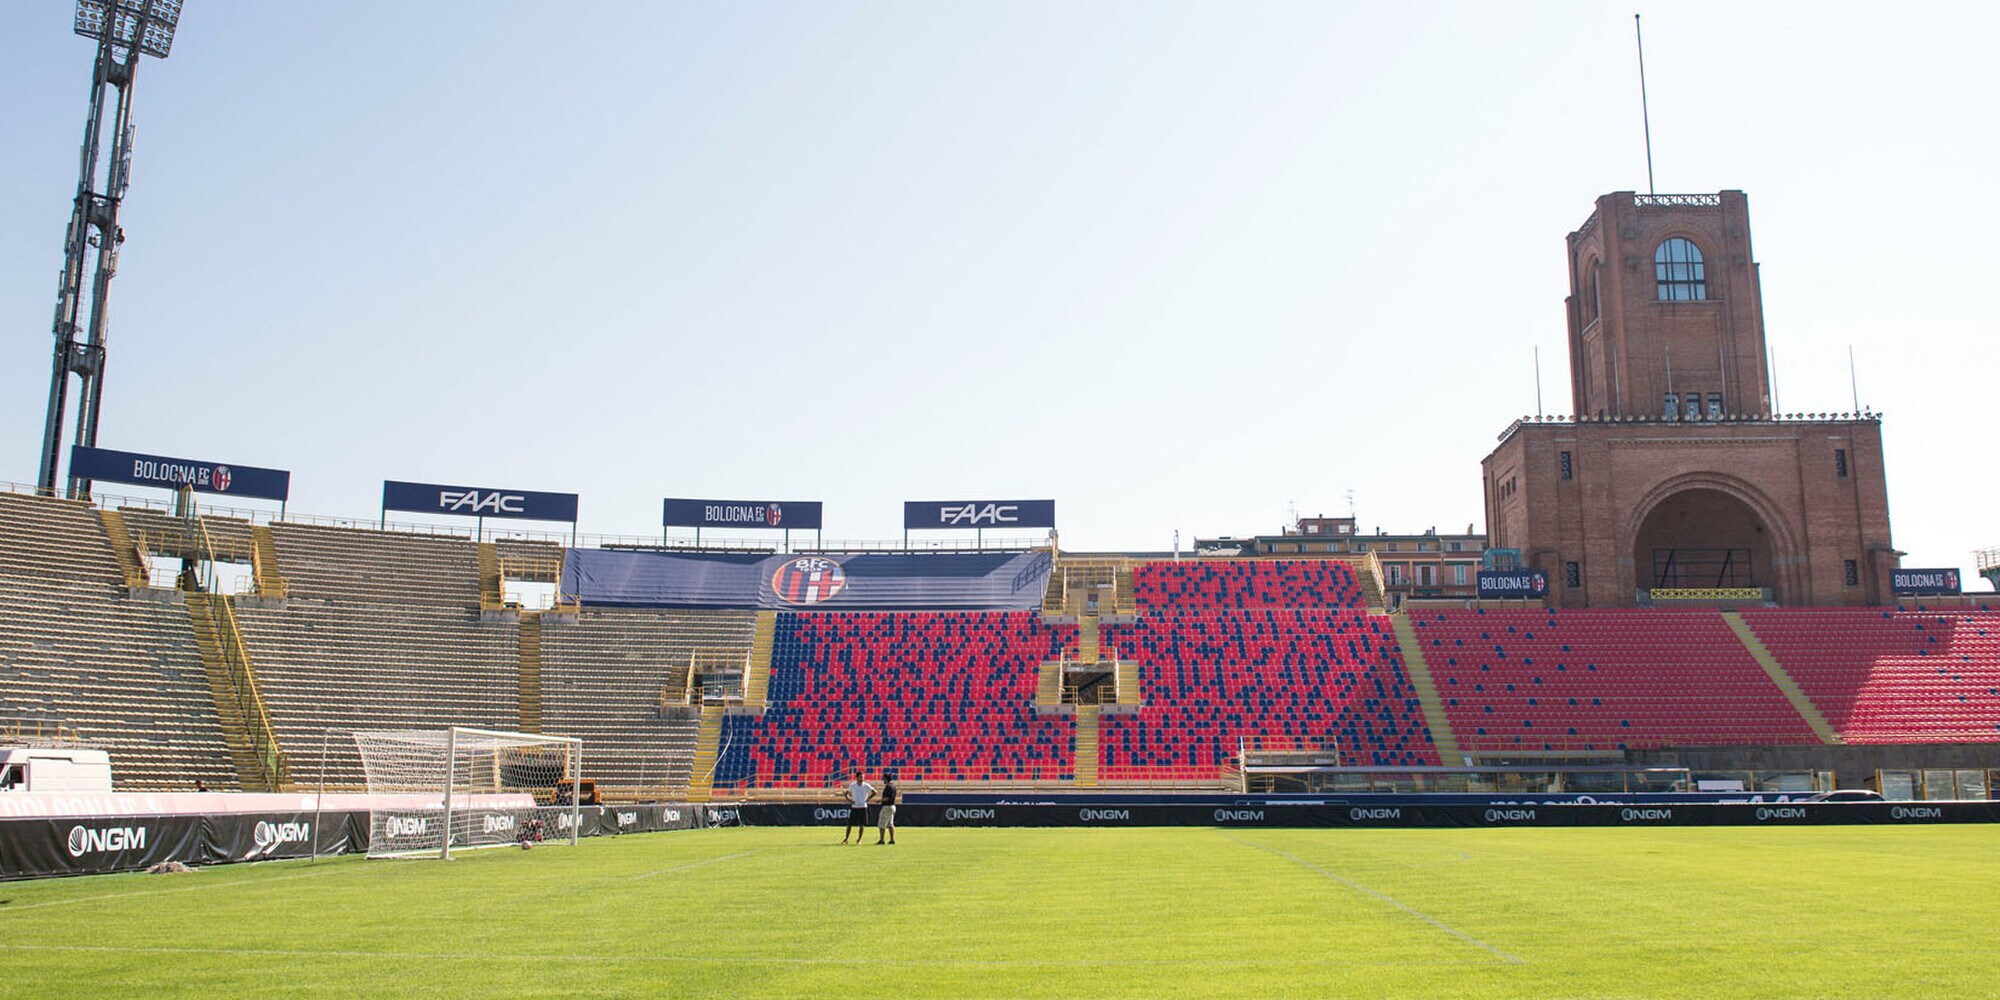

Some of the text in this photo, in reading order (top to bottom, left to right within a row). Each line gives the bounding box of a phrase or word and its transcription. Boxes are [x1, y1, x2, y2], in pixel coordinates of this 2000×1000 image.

[133, 459, 210, 484] BOLOGNA FC
[440, 490, 525, 513] FAAC
[705, 505, 765, 522] BOLOGNA FC
[940, 503, 1018, 525] FAAC
[795, 559, 829, 569] BFC
[1481, 576, 1522, 590] BOLOGNA
[1894, 574, 1936, 588] BOLOGNA
[957, 808, 995, 819] NGM
[1092, 809, 1130, 820] NGM
[1226, 810, 1265, 821] NGM
[1362, 808, 1401, 819] NGM
[1497, 809, 1536, 820] NGM
[1633, 809, 1672, 820] NGM
[1768, 807, 1806, 818] NGM
[1903, 807, 1942, 818] NGM
[394, 815, 426, 836] NGM
[489, 815, 515, 833] NGM
[87, 826, 146, 852] NGM
[268, 822, 309, 843] NGM
